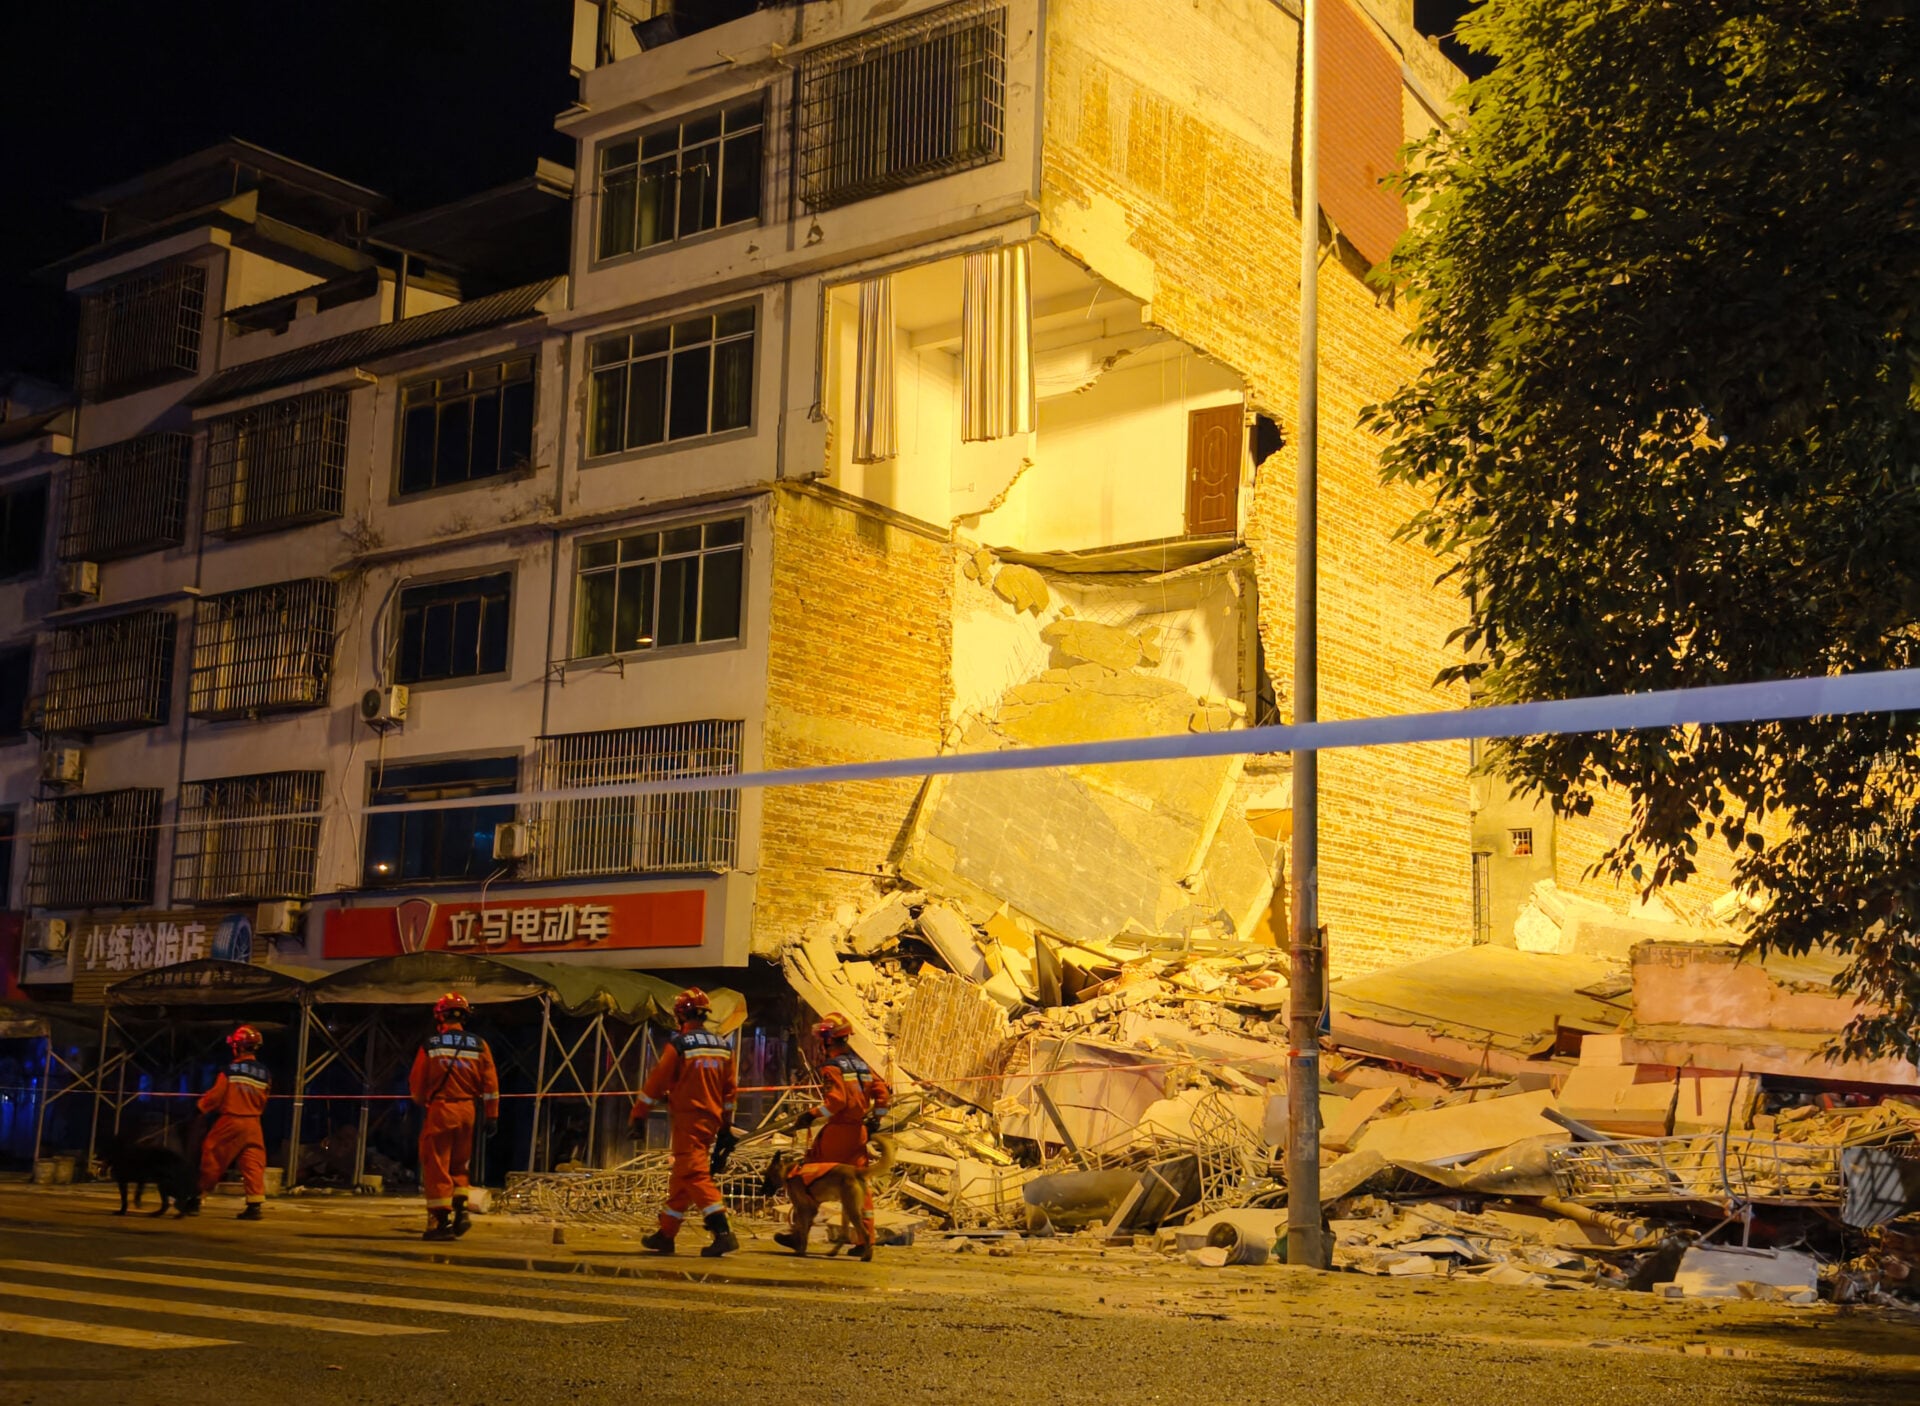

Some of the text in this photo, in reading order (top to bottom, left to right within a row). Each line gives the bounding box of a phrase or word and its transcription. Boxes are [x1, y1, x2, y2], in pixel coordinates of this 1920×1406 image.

[83, 921, 206, 971] 小练轮胎店
[447, 903, 611, 946] 立马电动车
